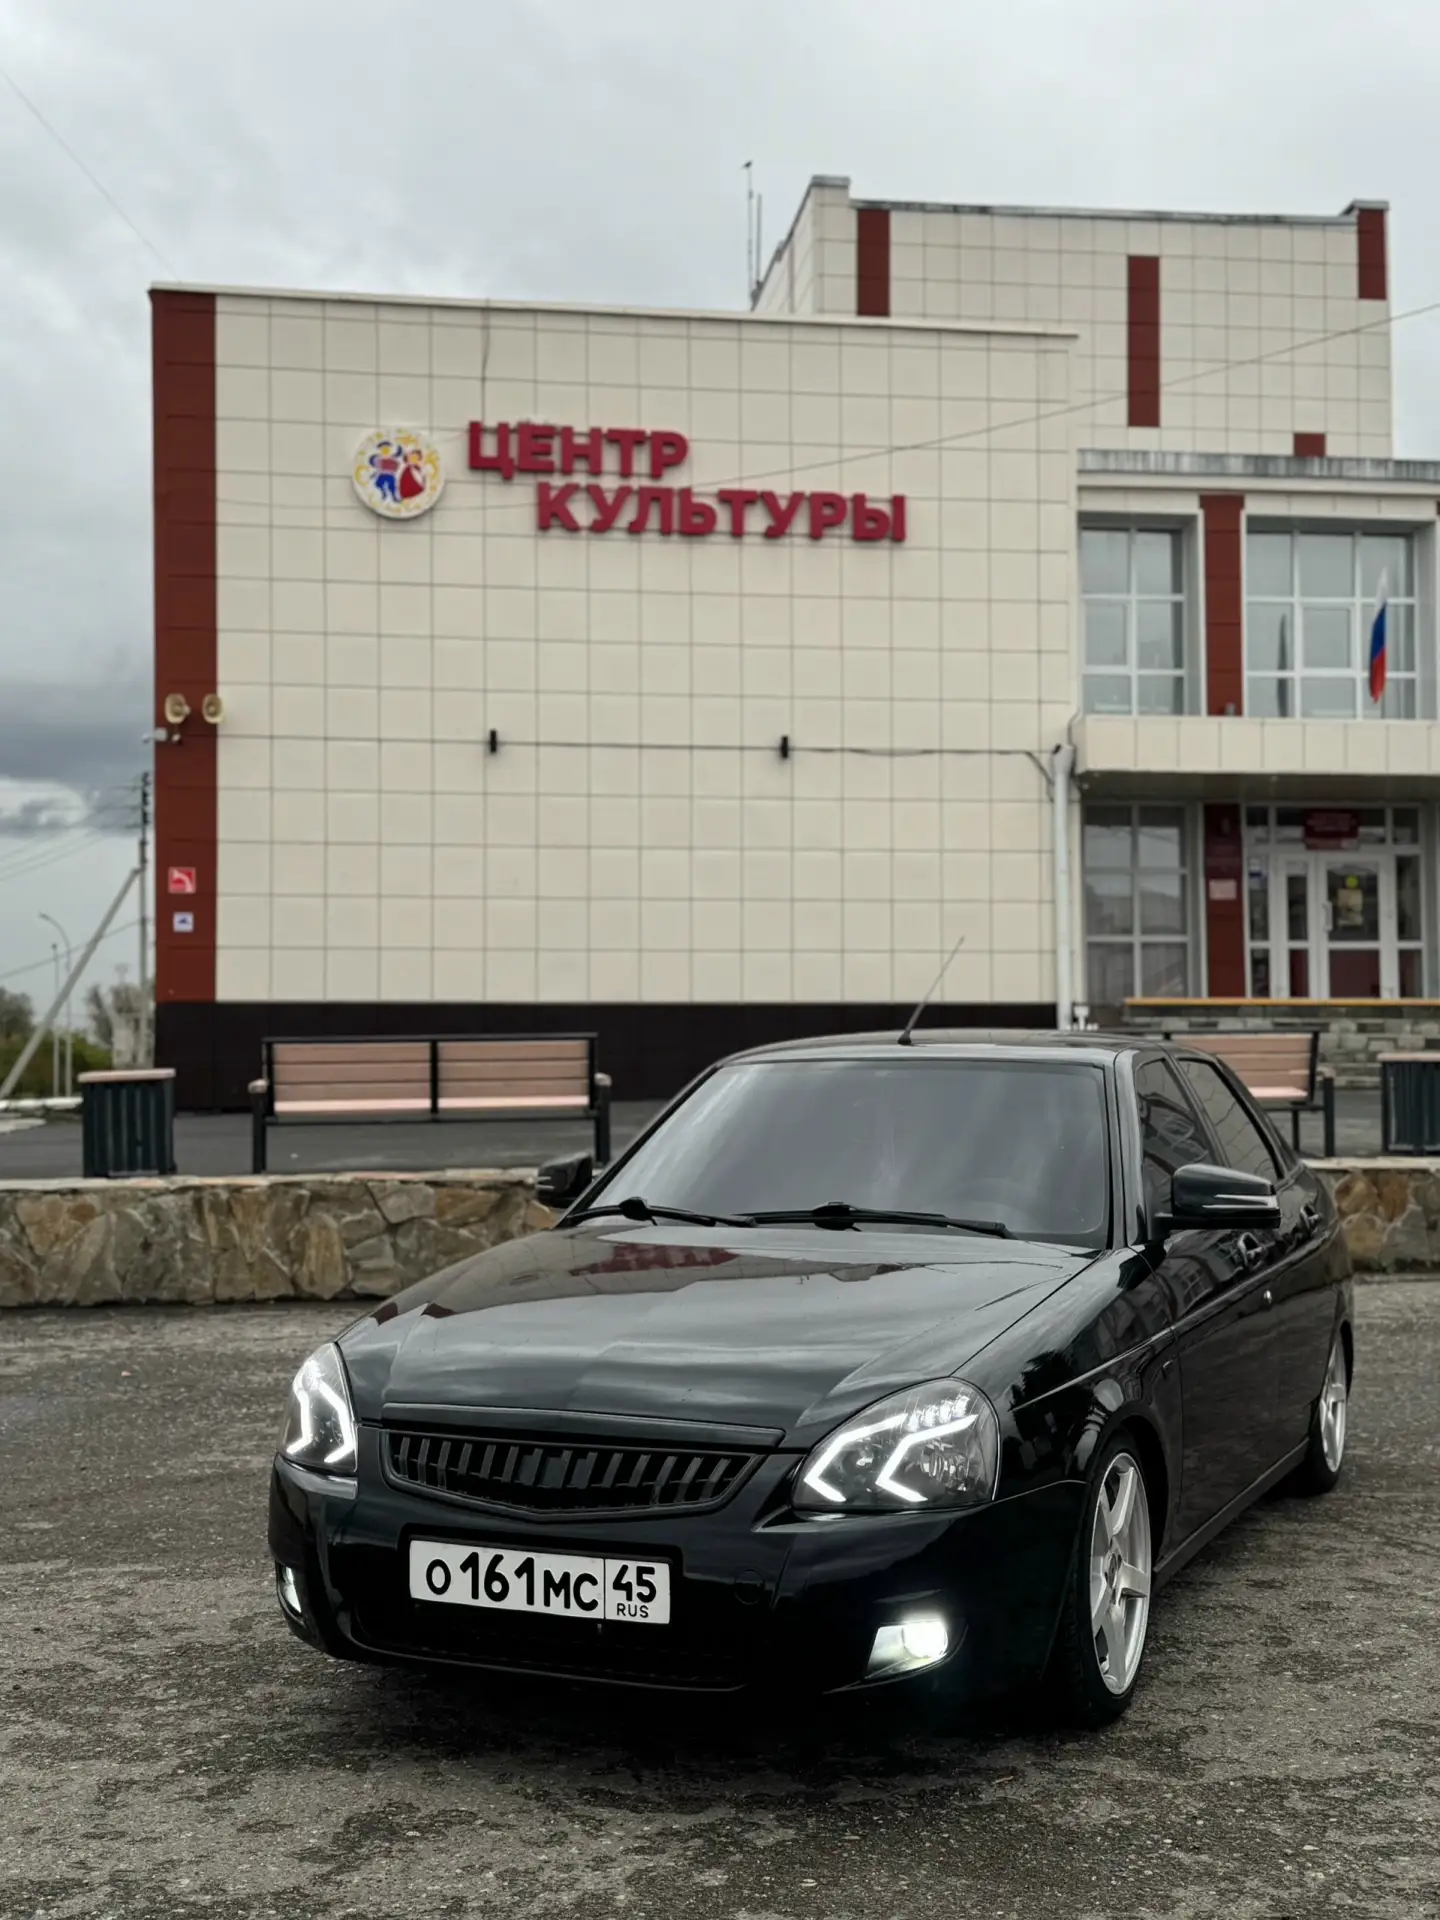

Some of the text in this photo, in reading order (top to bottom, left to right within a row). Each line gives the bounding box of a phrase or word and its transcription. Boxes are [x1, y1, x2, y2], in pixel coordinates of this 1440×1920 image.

[468, 421, 689, 479] ЦЕНТР
[537, 482, 906, 541] КУЛЬТУРЫ
[613, 1565, 656, 1603] 45
[616, 1603, 649, 1618] RUS
